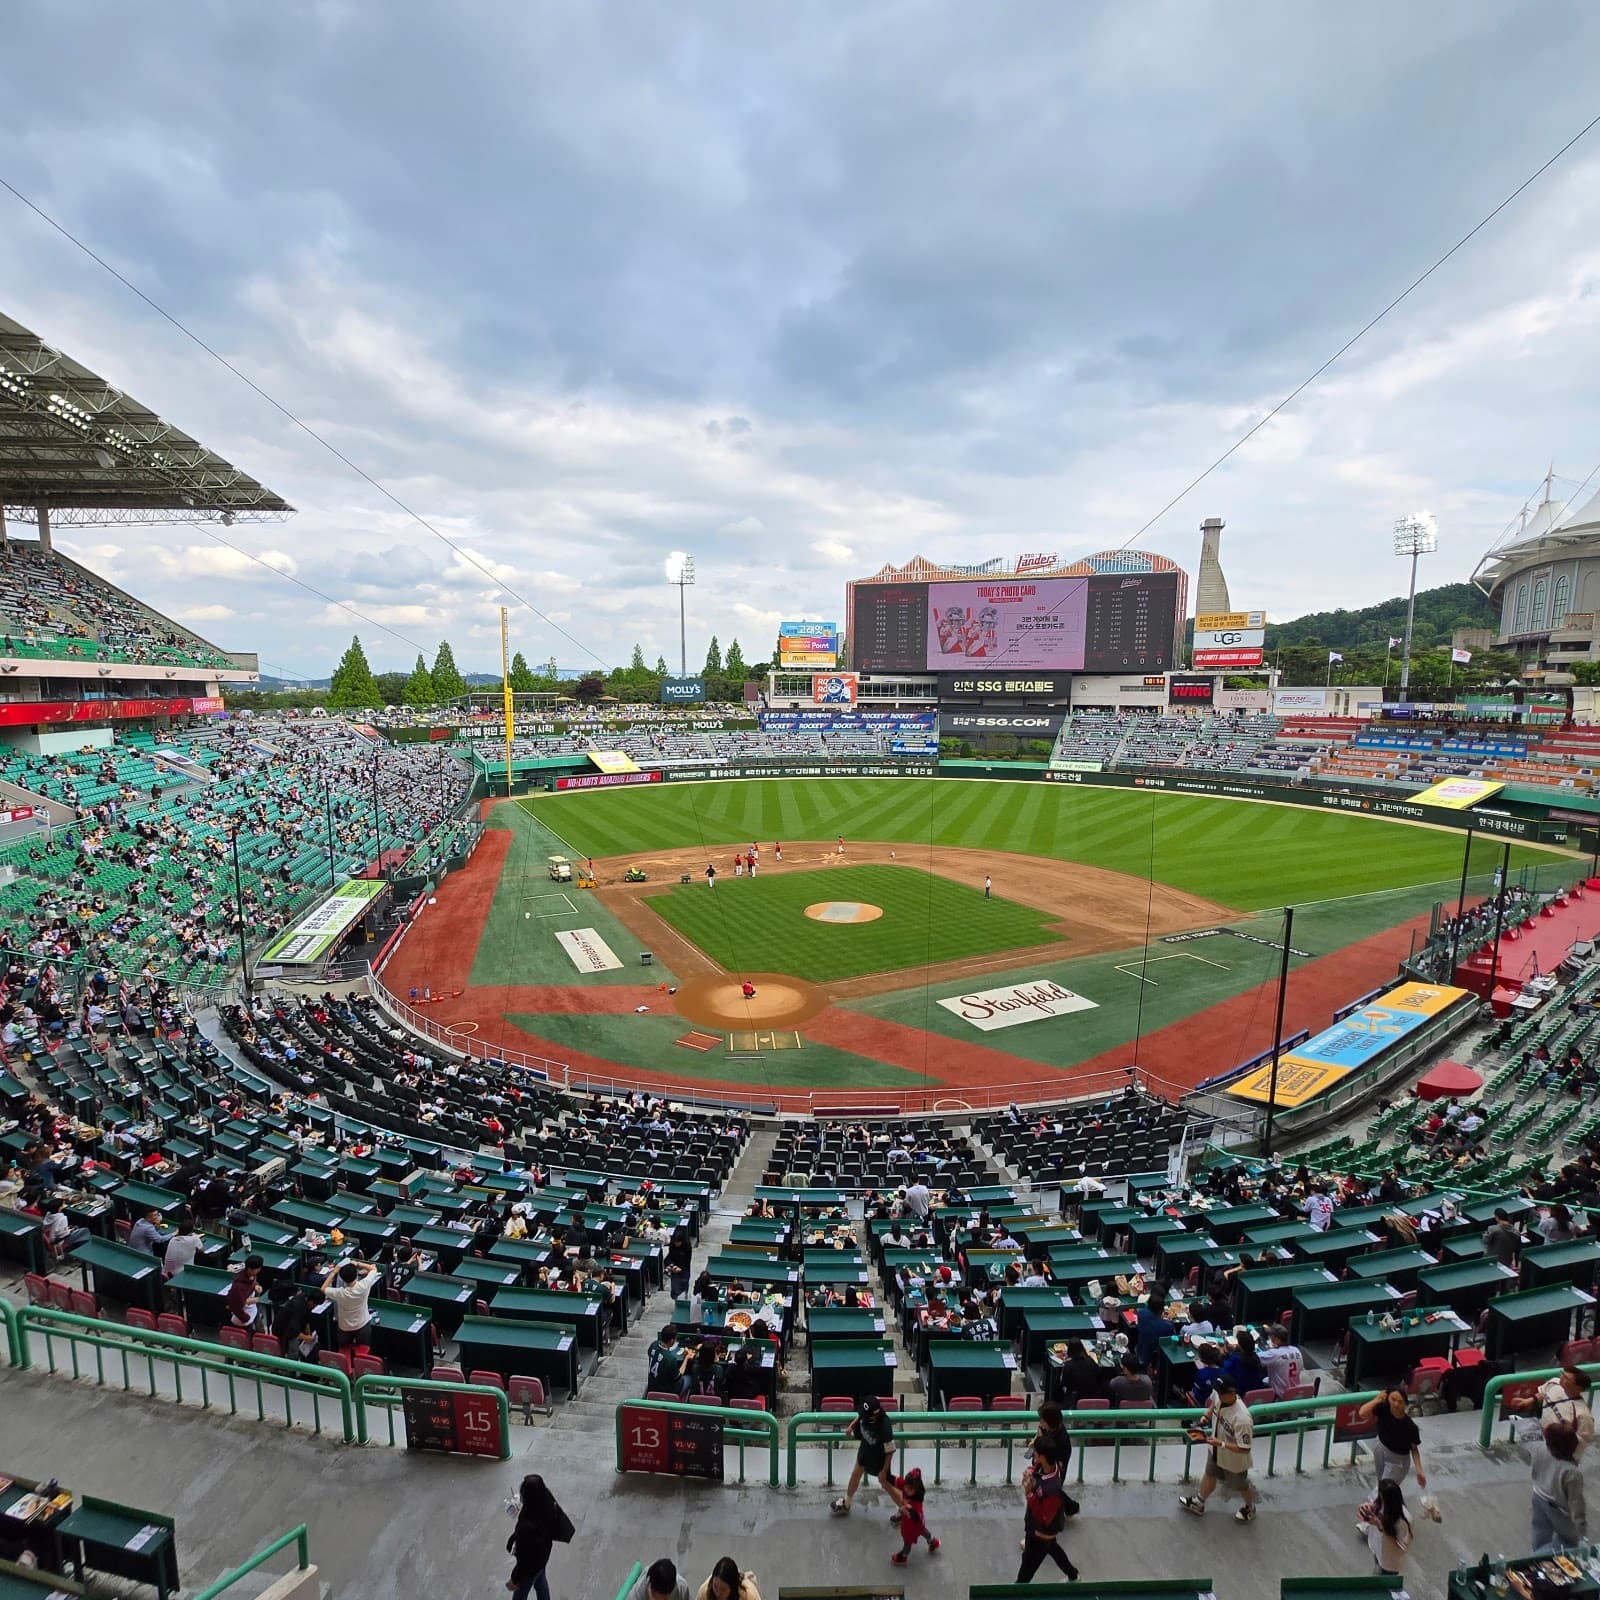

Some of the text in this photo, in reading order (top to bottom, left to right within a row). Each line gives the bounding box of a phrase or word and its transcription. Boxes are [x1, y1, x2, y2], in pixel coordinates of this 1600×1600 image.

[1016, 553, 1057, 574] Landers
[977, 585, 1036, 598] TODAY'S PHOTO CARD
[1214, 633, 1242, 645] UGG
[1122, 657, 1128, 665] 0
[1139, 657, 1145, 665] 0
[1156, 657, 1162, 665] 0
[666, 684, 701, 694] MOLLY'S
[954, 681, 1054, 692] 인천 SSG 랜더스필드
[693, 720, 724, 729] MOLLY'S
[976, 718, 1050, 727] SSG.COM
[567, 773, 651, 788] NO-LIMITS AMAZING LANDERS
[1054, 772, 1082, 781] 반도건설
[960, 981, 1074, 1020] Starfield
[1320, 1203, 1332, 1214] 35
[393, 1275, 402, 1288] 2
[1288, 1362, 1297, 1378] 2
[463, 1411, 491, 1432] 15
[631, 1427, 660, 1448] 13
